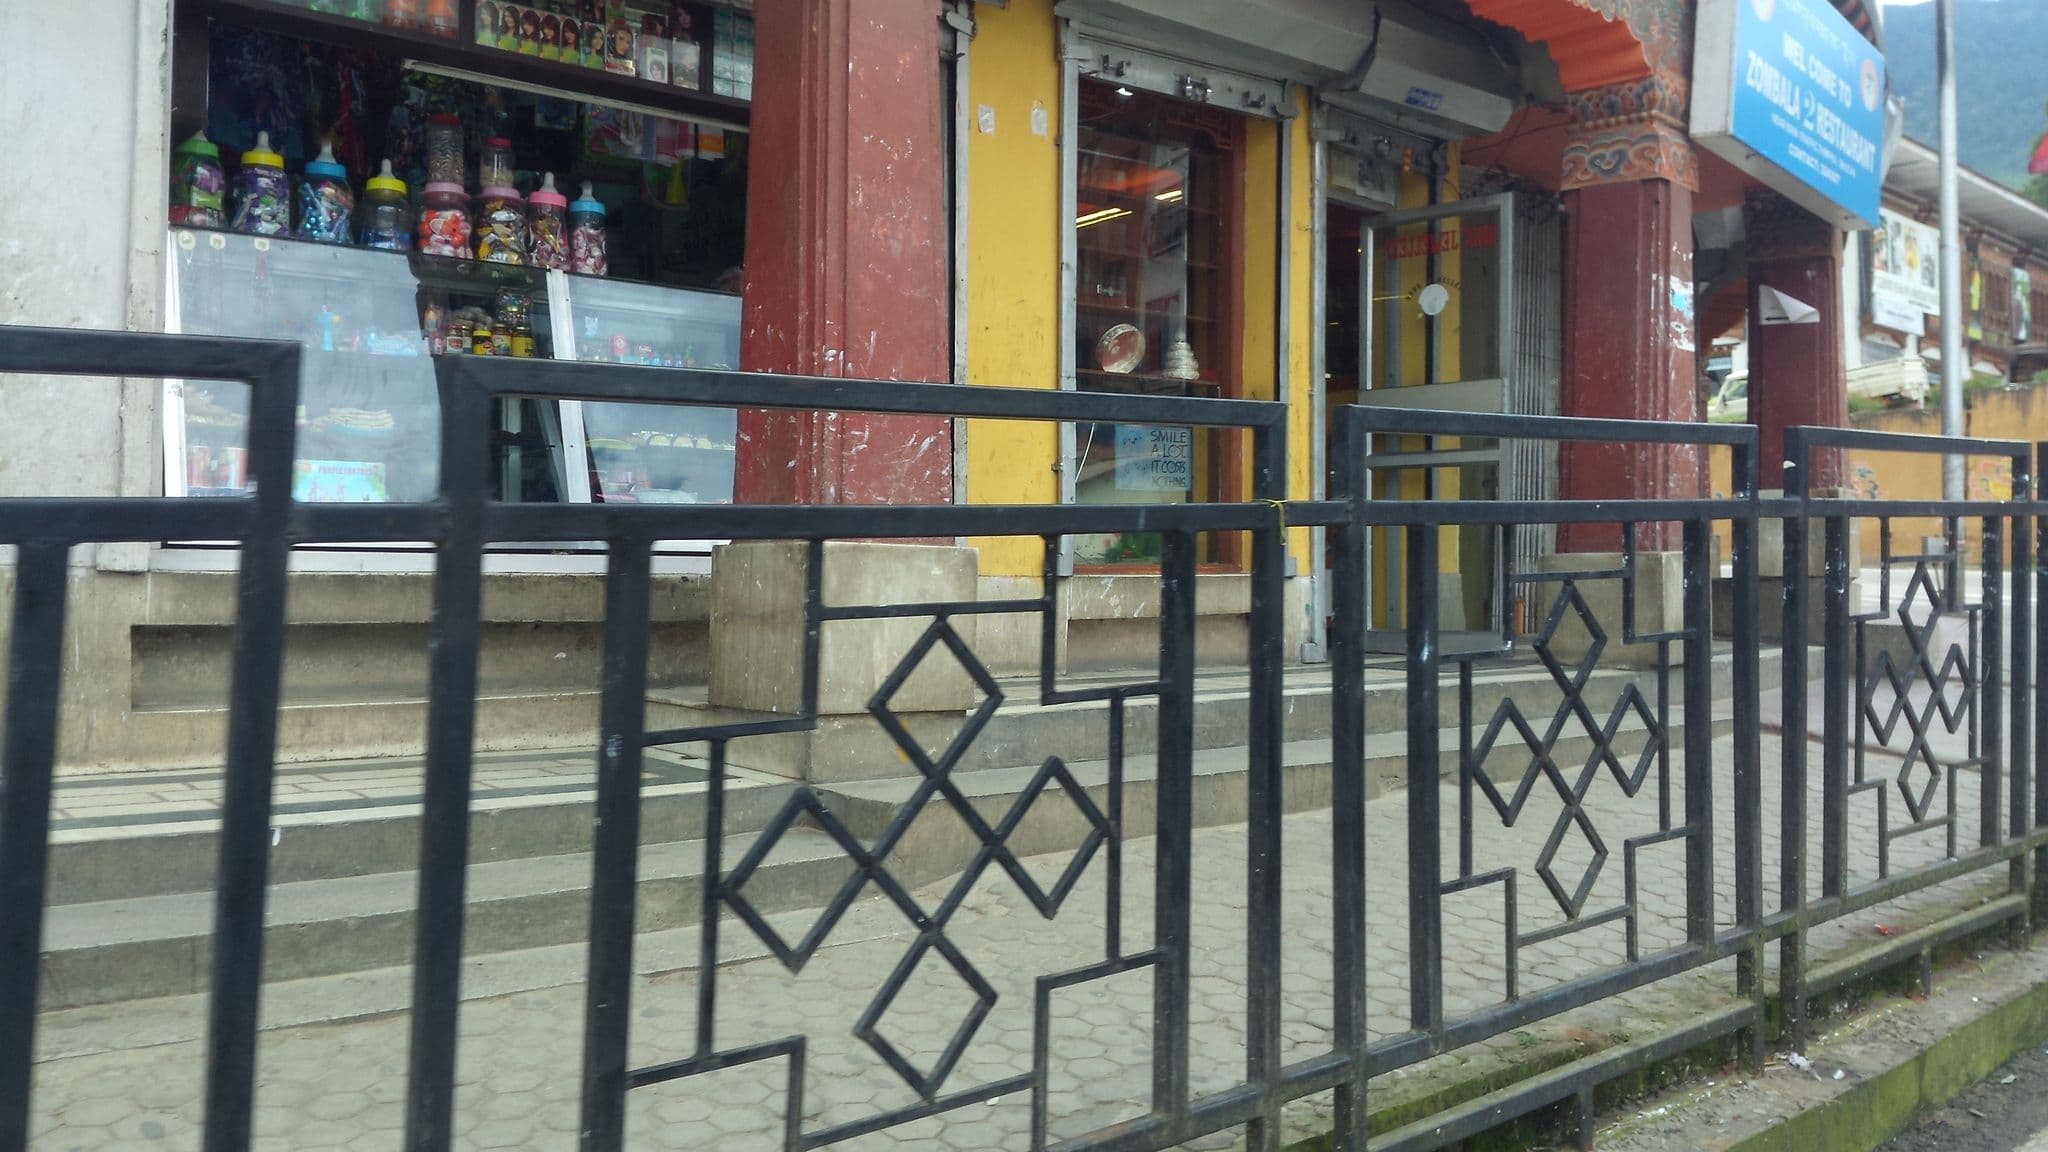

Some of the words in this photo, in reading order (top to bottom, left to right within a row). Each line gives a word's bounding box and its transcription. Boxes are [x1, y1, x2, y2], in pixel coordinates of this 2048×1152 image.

[1839, 78, 1852, 109] TO
[1816, 102, 1876, 173] RESTAURANT
[1150, 430, 1187, 443] SMILE
[1163, 444, 1188, 459] LOT
[1151, 460, 1161, 473] IT
